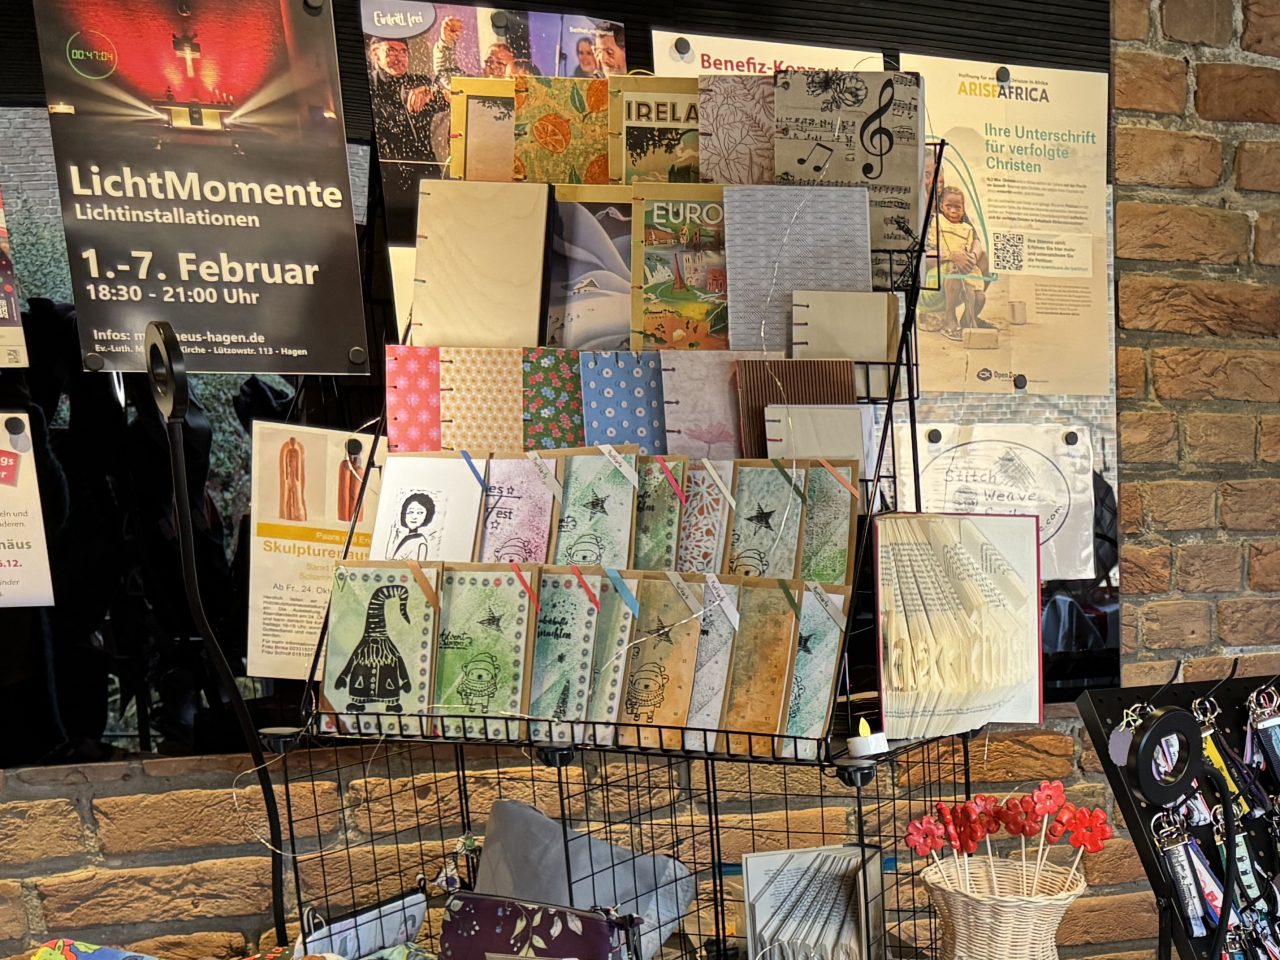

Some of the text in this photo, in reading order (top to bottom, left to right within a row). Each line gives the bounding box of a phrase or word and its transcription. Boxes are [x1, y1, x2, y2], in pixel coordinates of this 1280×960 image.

[626, 100, 699, 123] IRELA
[985, 122, 1097, 144] Ihre Unterschrift
[985, 140, 1070, 160] für verfolgte
[986, 156, 1042, 173] Christen
[70, 165, 343, 208] LichtMomente
[75, 203, 260, 228] Lichtinstallationen
[653, 203, 724, 226] EURO
[82, 248, 319, 285] 1.-7. Februar
[86, 284, 142, 301] 18:30
[163, 287, 217, 304] 21:00
[223, 288, 260, 305] Uhr
[93, 329, 131, 342] Infos:
[281, 348, 308, 357] Hagen
[944, 470, 997, 484] Stitch
[983, 489, 1037, 502] Weave
